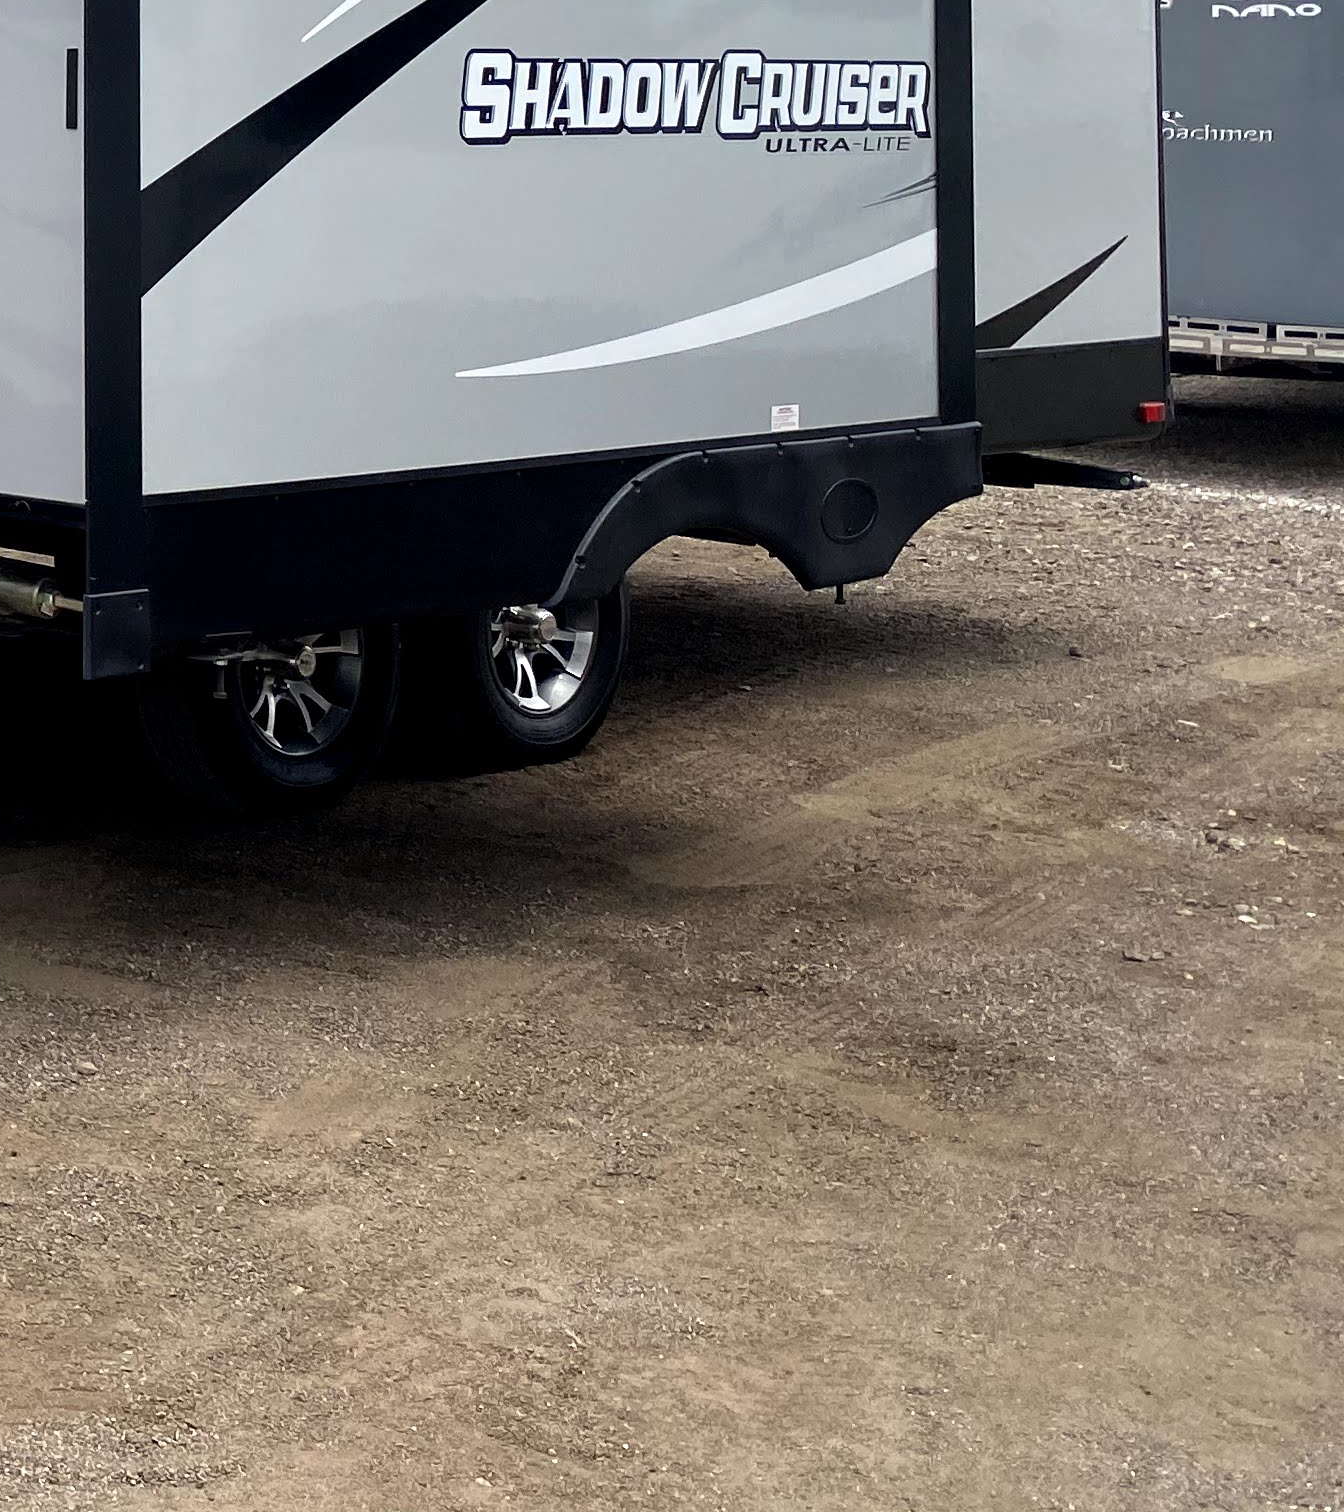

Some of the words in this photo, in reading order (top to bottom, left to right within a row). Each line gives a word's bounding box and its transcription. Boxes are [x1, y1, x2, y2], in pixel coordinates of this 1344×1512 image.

[460, 49, 720, 145] SHADOW
[716, 49, 931, 140] CRUISER
[1162, 123, 1274, 142] oachmen
[765, 135, 912, 154] ULTRA-LITE
